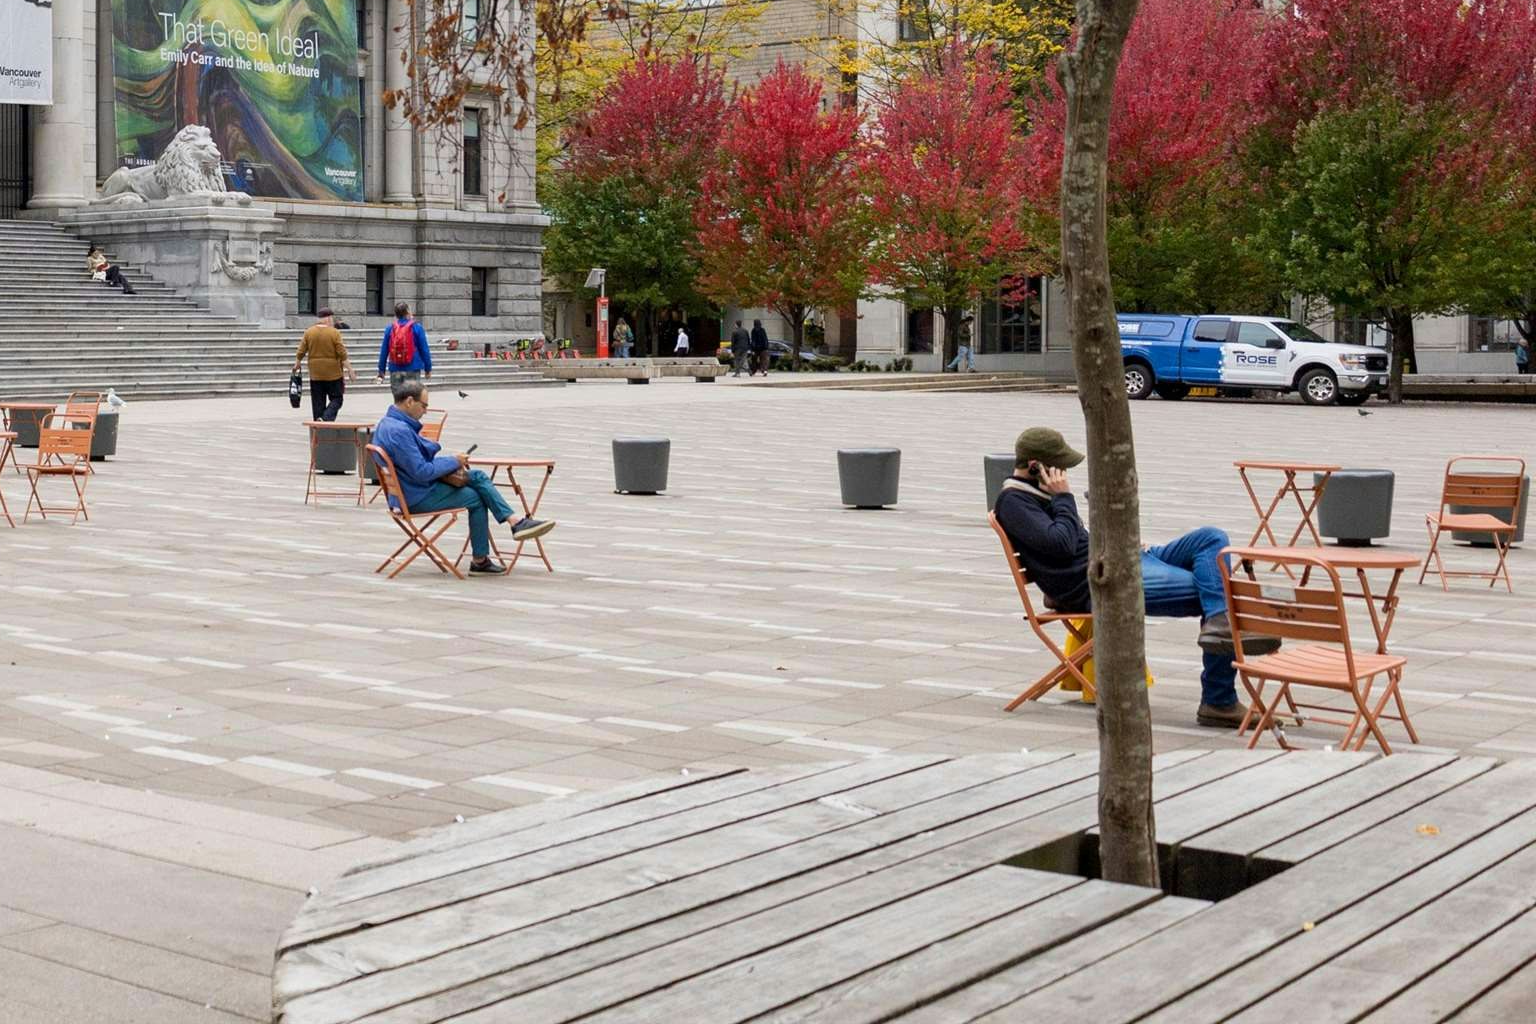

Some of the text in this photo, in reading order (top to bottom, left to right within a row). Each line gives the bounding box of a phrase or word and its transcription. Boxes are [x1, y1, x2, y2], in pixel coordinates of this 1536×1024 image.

[158, 12, 320, 60] That Green Ideal
[0, 66, 42, 77] Vancouver
[160, 48, 320, 79] Emily Carr and the Idea of Nature
[1235, 353, 1277, 365] ROSE
